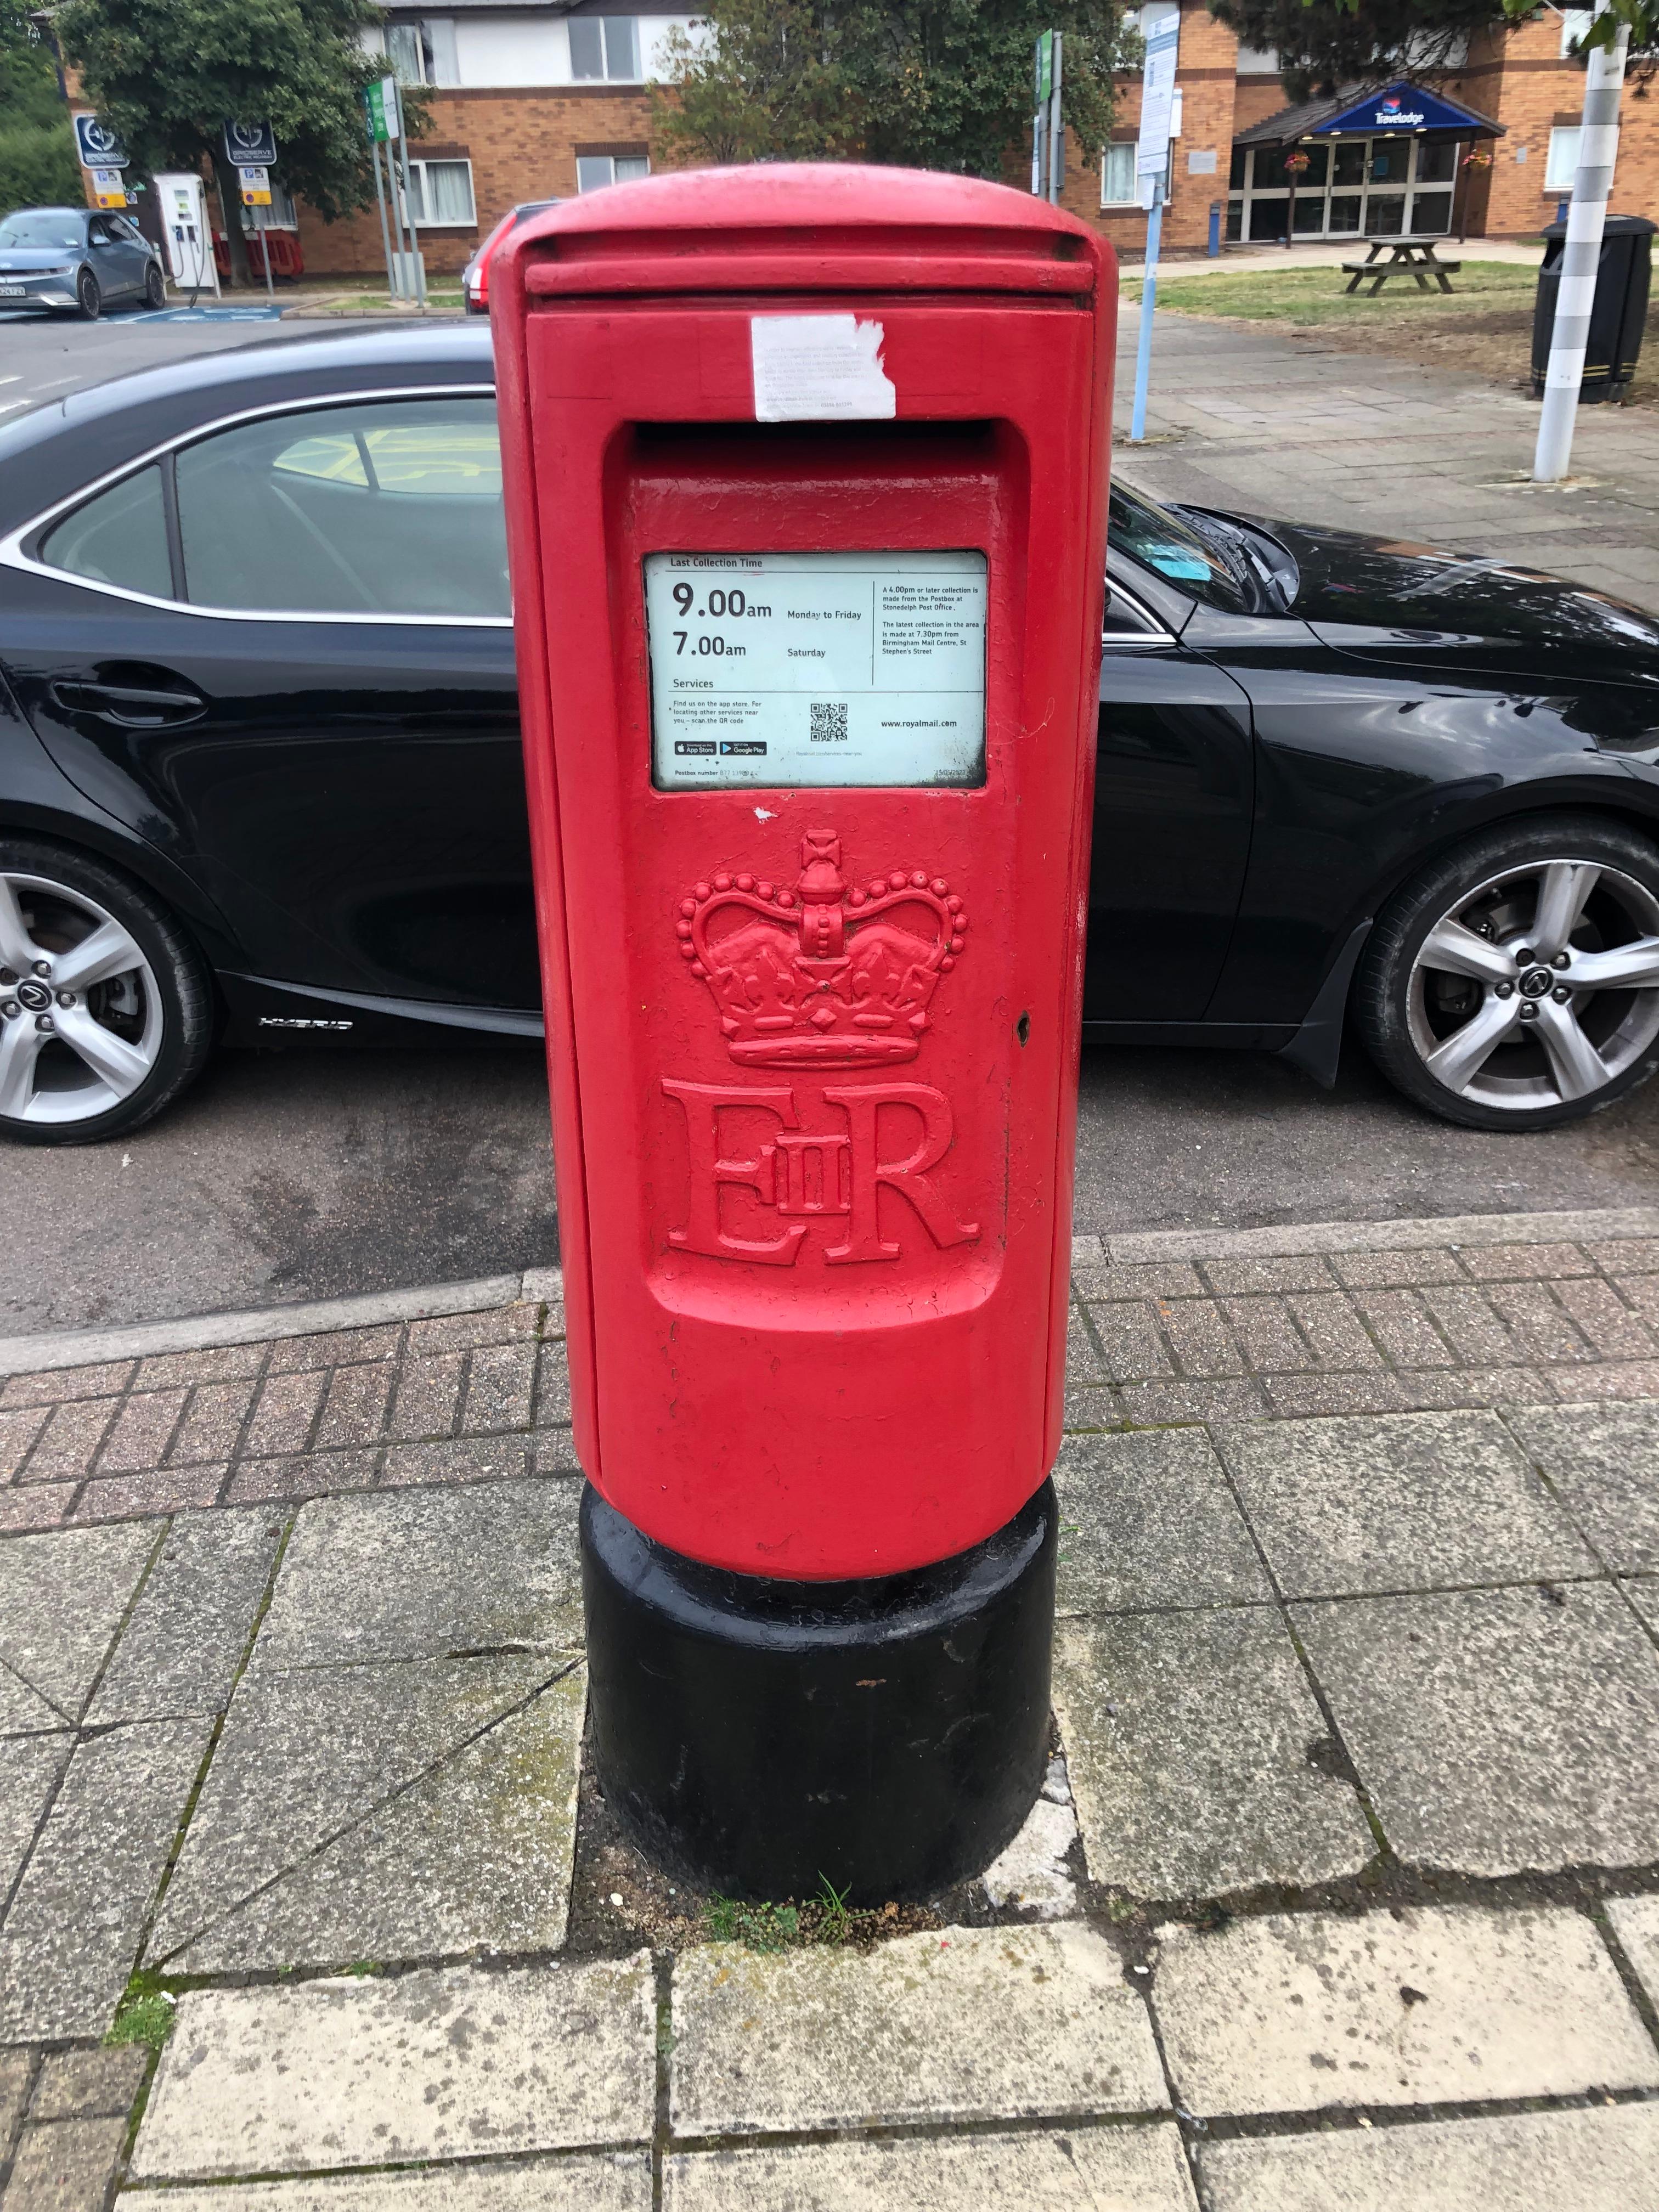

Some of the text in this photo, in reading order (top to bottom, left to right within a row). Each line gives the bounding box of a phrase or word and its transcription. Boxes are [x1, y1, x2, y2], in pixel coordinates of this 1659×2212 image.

[1375, 112, 1424, 125] Travelodge
[671, 558, 763, 567] Last Collection Time
[889, 586, 915, 594] 4.00pm
[673, 582, 772, 617] 9.00am
[788, 610, 821, 620] Monday
[836, 611, 861, 620] Friday
[673, 631, 746, 656] 7.00am
[788, 648, 826, 658] Saturday
[673, 679, 714, 688] Services
[881, 720, 957, 729] www.royalmail.com
